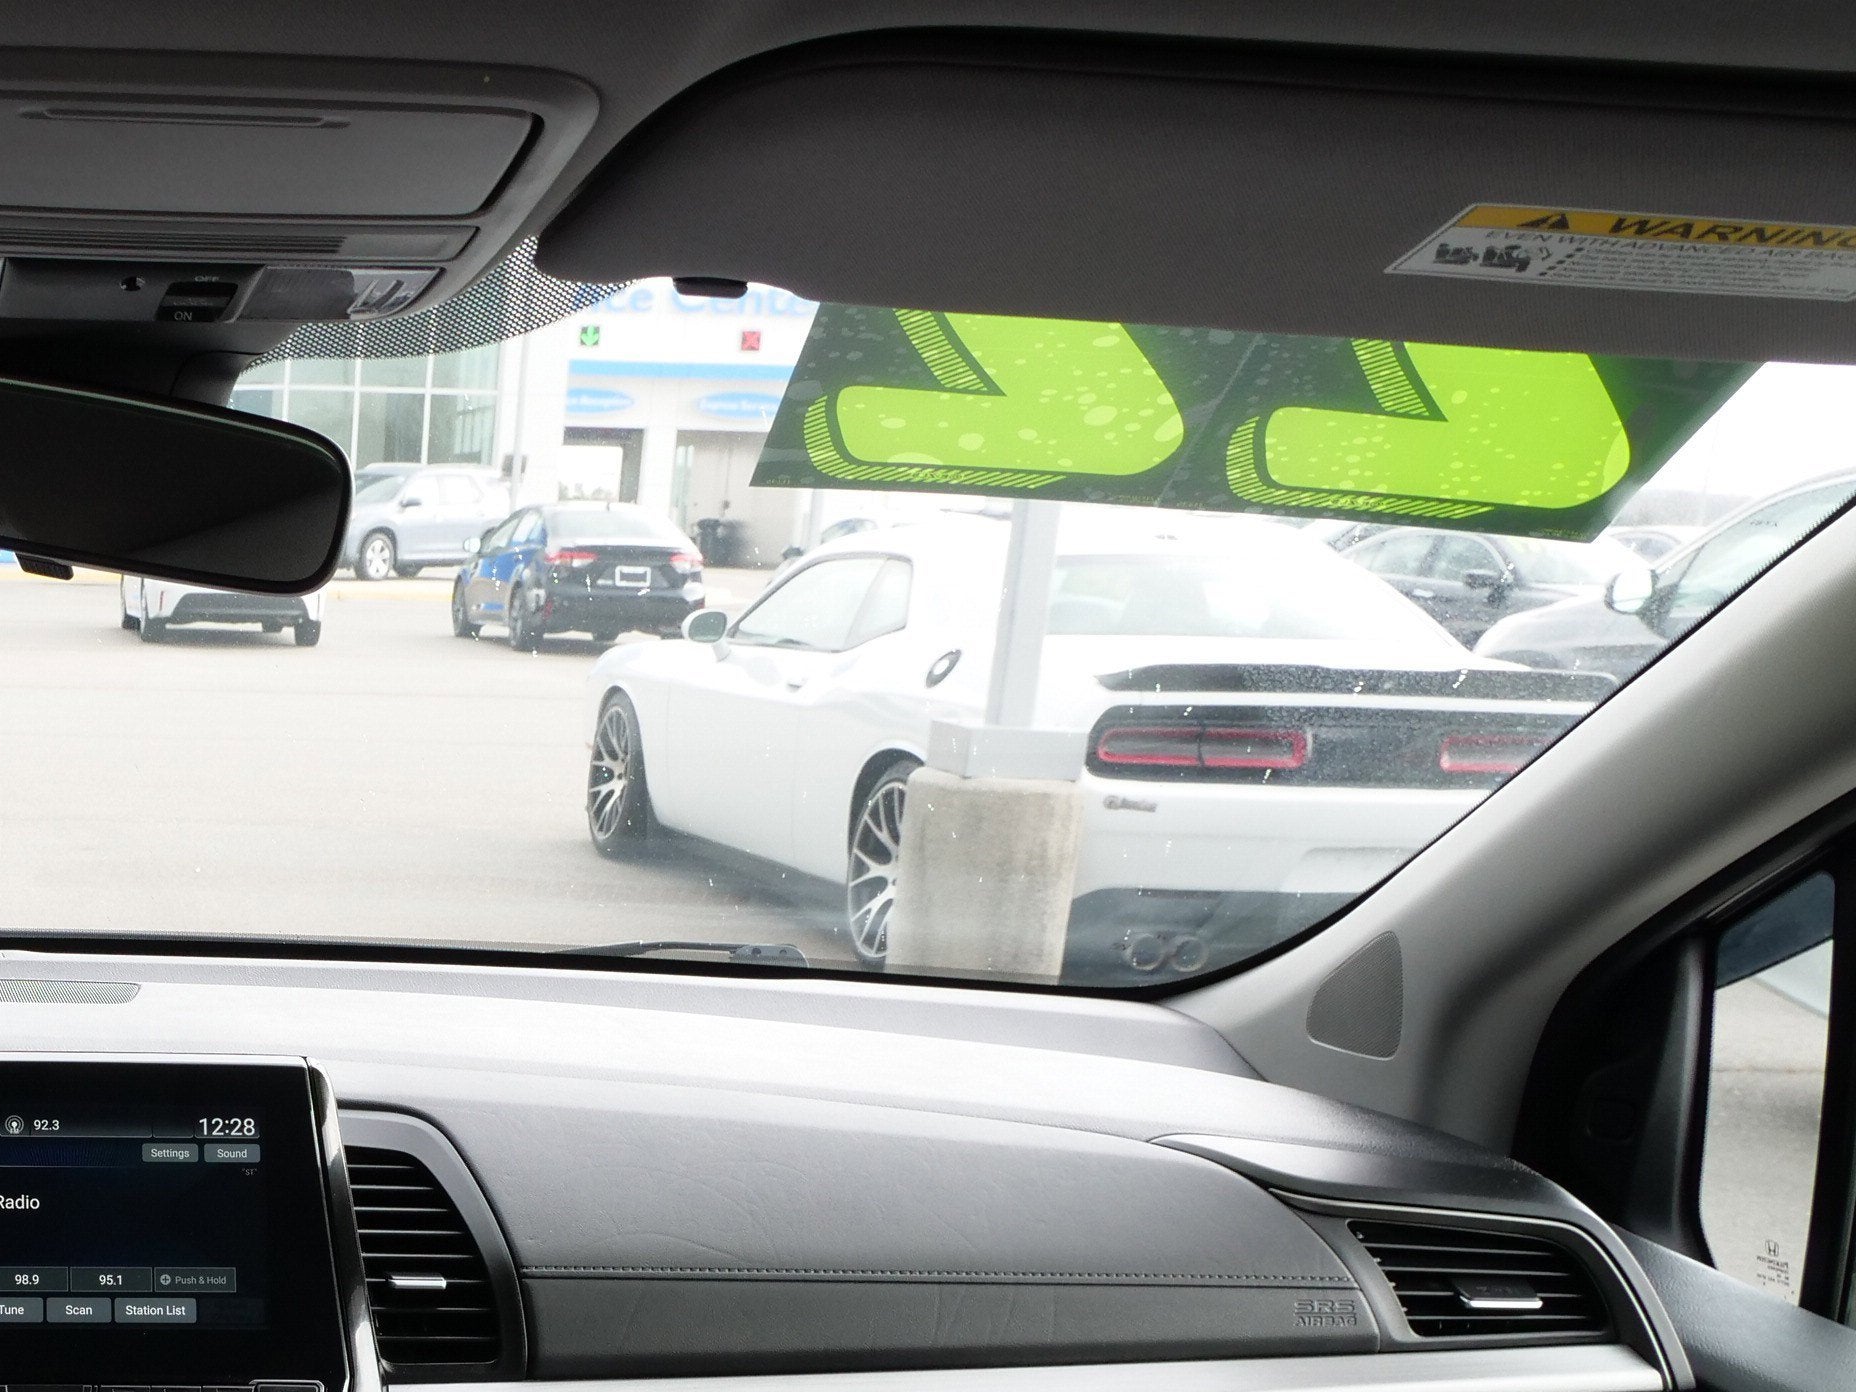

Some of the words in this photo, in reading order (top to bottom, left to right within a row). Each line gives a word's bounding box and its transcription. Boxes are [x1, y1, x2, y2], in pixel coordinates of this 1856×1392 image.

[173, 311, 193, 321] ON
[33, 1119, 60, 1131] 92.3
[198, 1117, 256, 1136] 12:28
[150, 1148, 191, 1160] Settings
[217, 1148, 248, 1158] Sound
[14, 1274, 40, 1285] 98.9
[98, 1274, 123, 1286] 95.1
[175, 1275, 197, 1285] Push
[198, 1276, 205, 1285] &
[206, 1275, 227, 1285] Hold
[65, 1305, 93, 1316] Scan
[125, 1304, 165, 1316] Station
[166, 1304, 186, 1316] List
[1293, 1299, 1356, 1313] SRS
[1293, 1314, 1357, 1327] AIRBAG
